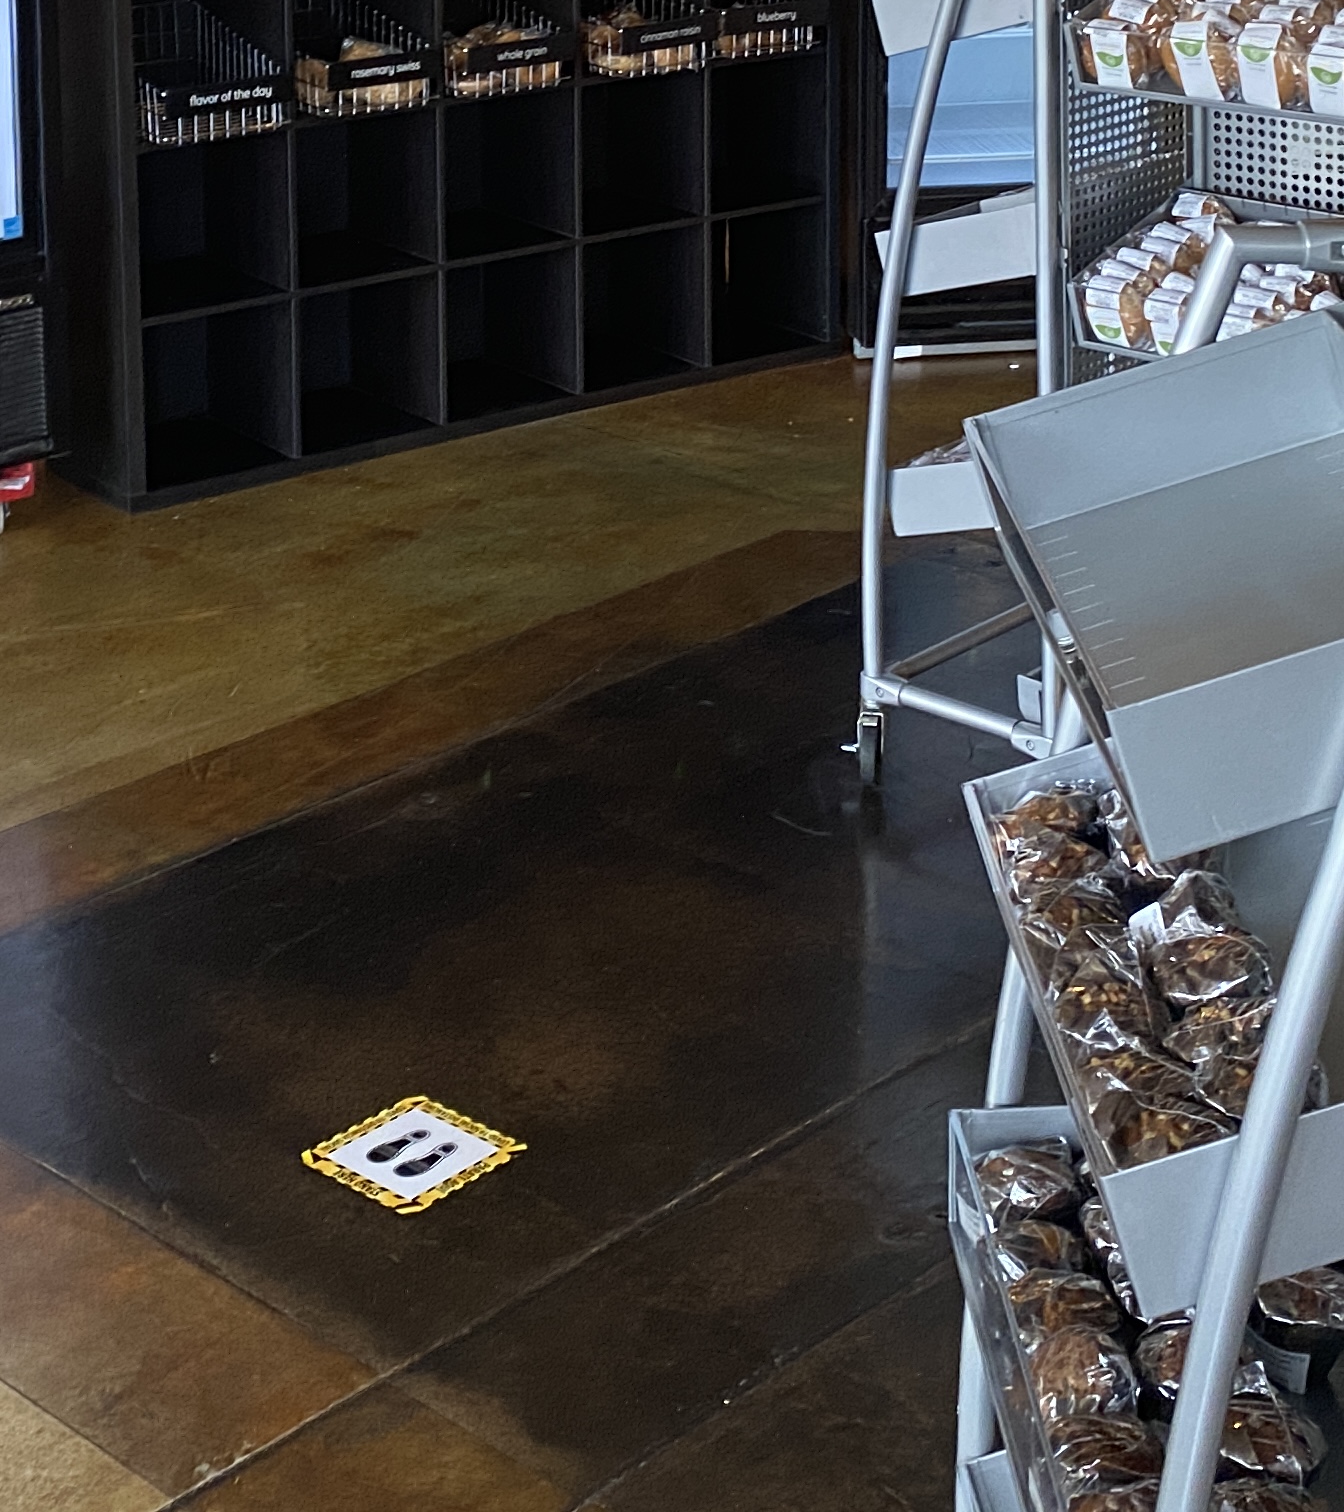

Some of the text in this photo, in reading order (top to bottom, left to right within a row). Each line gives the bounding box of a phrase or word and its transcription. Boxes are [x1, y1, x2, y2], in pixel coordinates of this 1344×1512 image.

[757, 10, 796, 23] blueberry
[640, 25, 701, 43] cinnamon raisin
[497, 45, 548, 61] whole grain
[351, 61, 421, 79] rosemary swiss
[189, 85, 273, 107] flavor of the day
